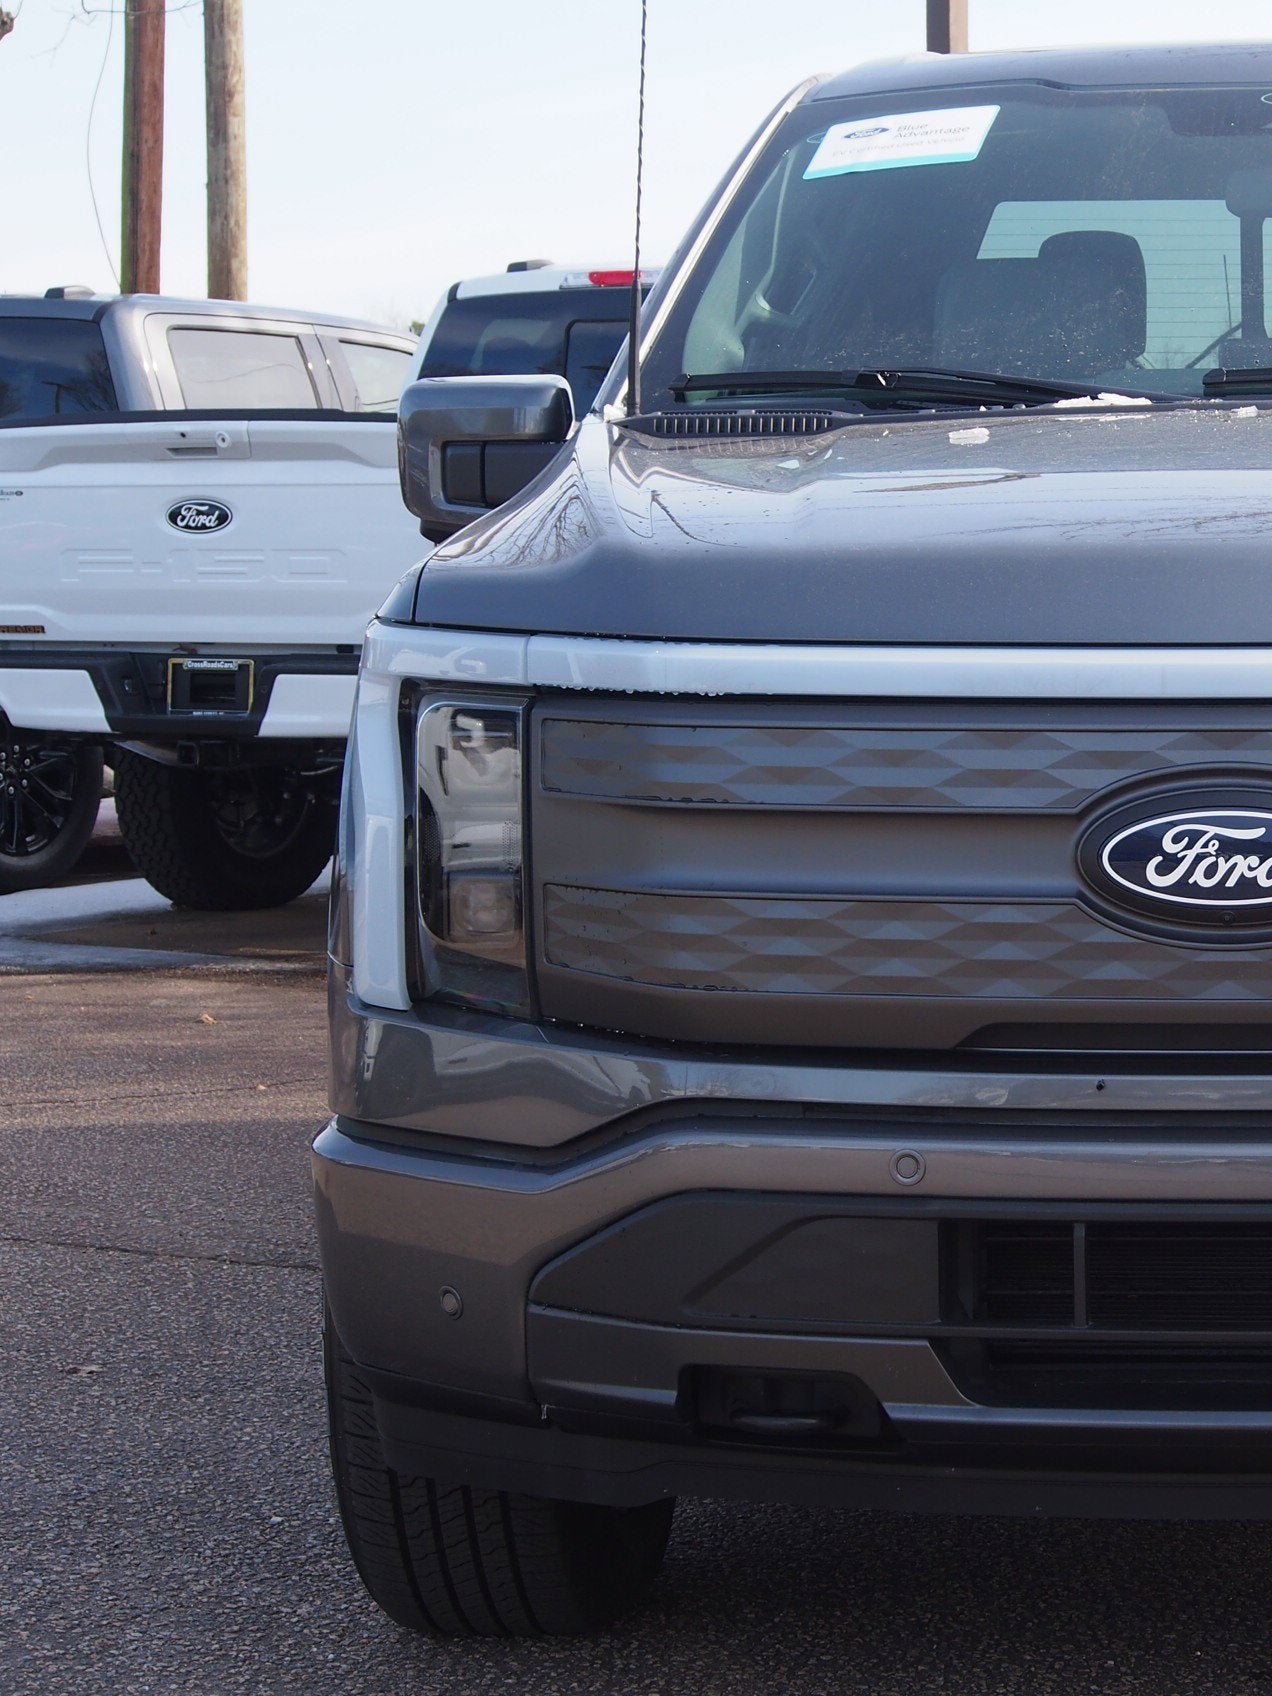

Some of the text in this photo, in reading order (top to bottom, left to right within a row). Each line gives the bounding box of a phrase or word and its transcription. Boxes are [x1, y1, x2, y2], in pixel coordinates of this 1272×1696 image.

[895, 126, 971, 139] Advantage
[897, 123, 929, 132] Blue
[176, 504, 219, 527] Ford
[60, 548, 347, 583] F-150
